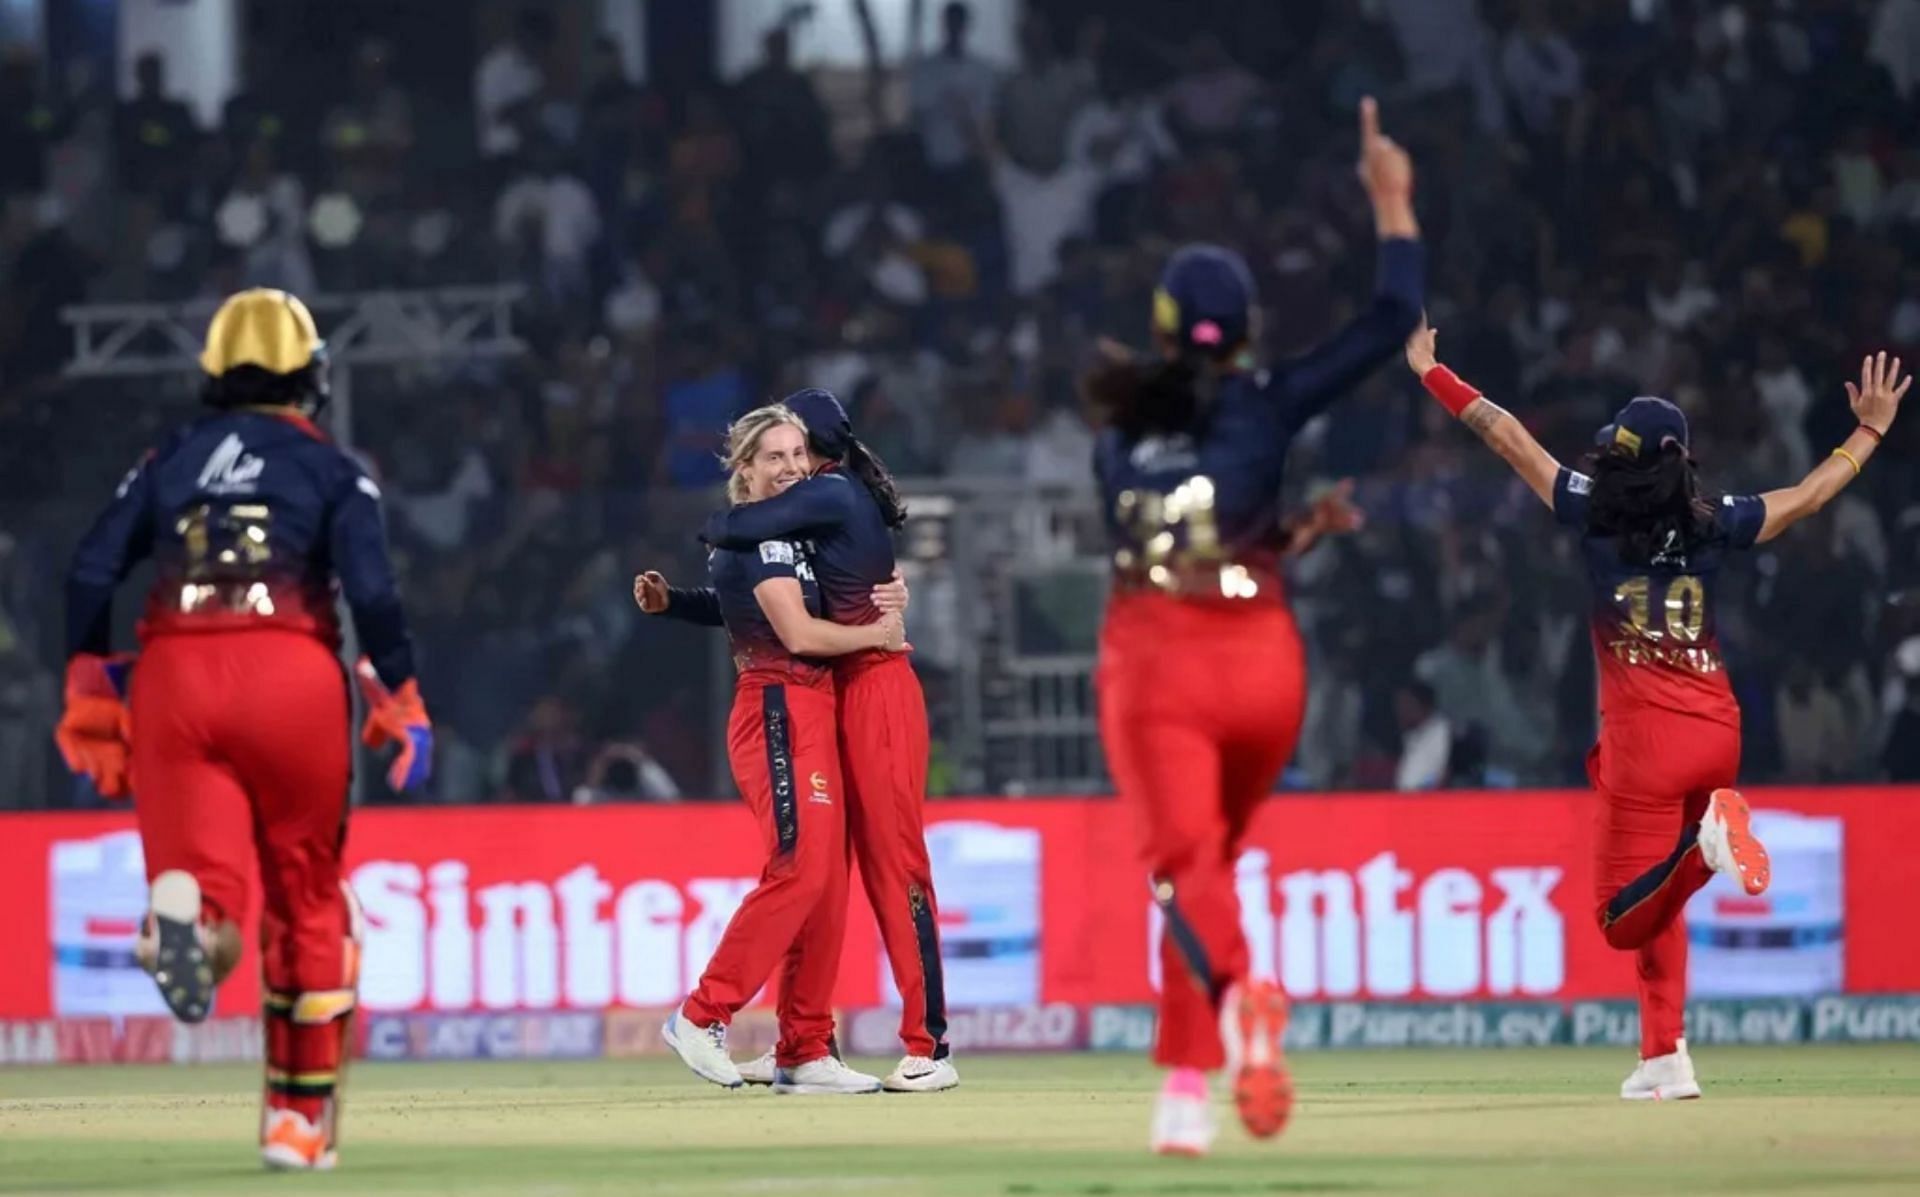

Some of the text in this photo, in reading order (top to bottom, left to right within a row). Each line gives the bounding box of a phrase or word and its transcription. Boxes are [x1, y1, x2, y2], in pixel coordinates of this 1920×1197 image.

[1614, 575, 1704, 641] 10
[350, 860, 764, 1009] Sintex
[1149, 849, 1565, 997] intex
[1331, 1002, 1560, 1046] Punch.ev
[1573, 1001, 1800, 1046] Puh.ev
